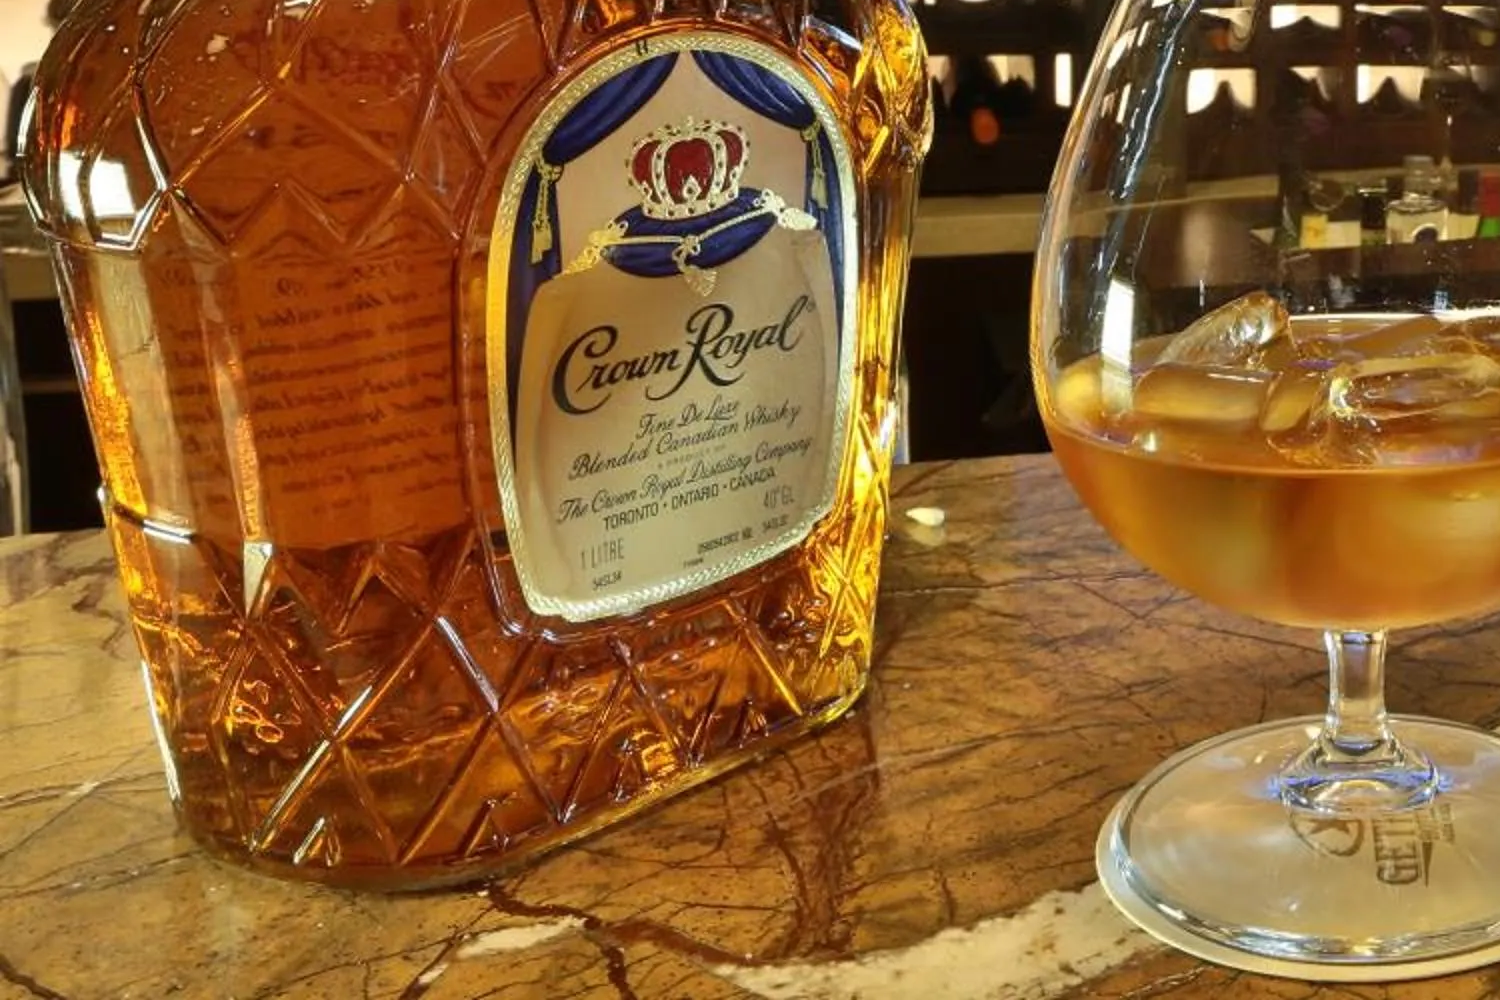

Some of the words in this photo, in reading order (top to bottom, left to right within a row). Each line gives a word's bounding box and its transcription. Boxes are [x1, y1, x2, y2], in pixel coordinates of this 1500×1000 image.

[552, 325, 681, 415] Crown
[645, 296, 809, 400] Royal
[568, 441, 654, 481] Blended
[656, 421, 739, 455] Canadian
[744, 398, 802, 432] Whisky
[555, 496, 589, 524] The
[603, 501, 660, 531] TORONTO
[671, 482, 720, 511] ONTARIO
[729, 465, 776, 492] CANADA
